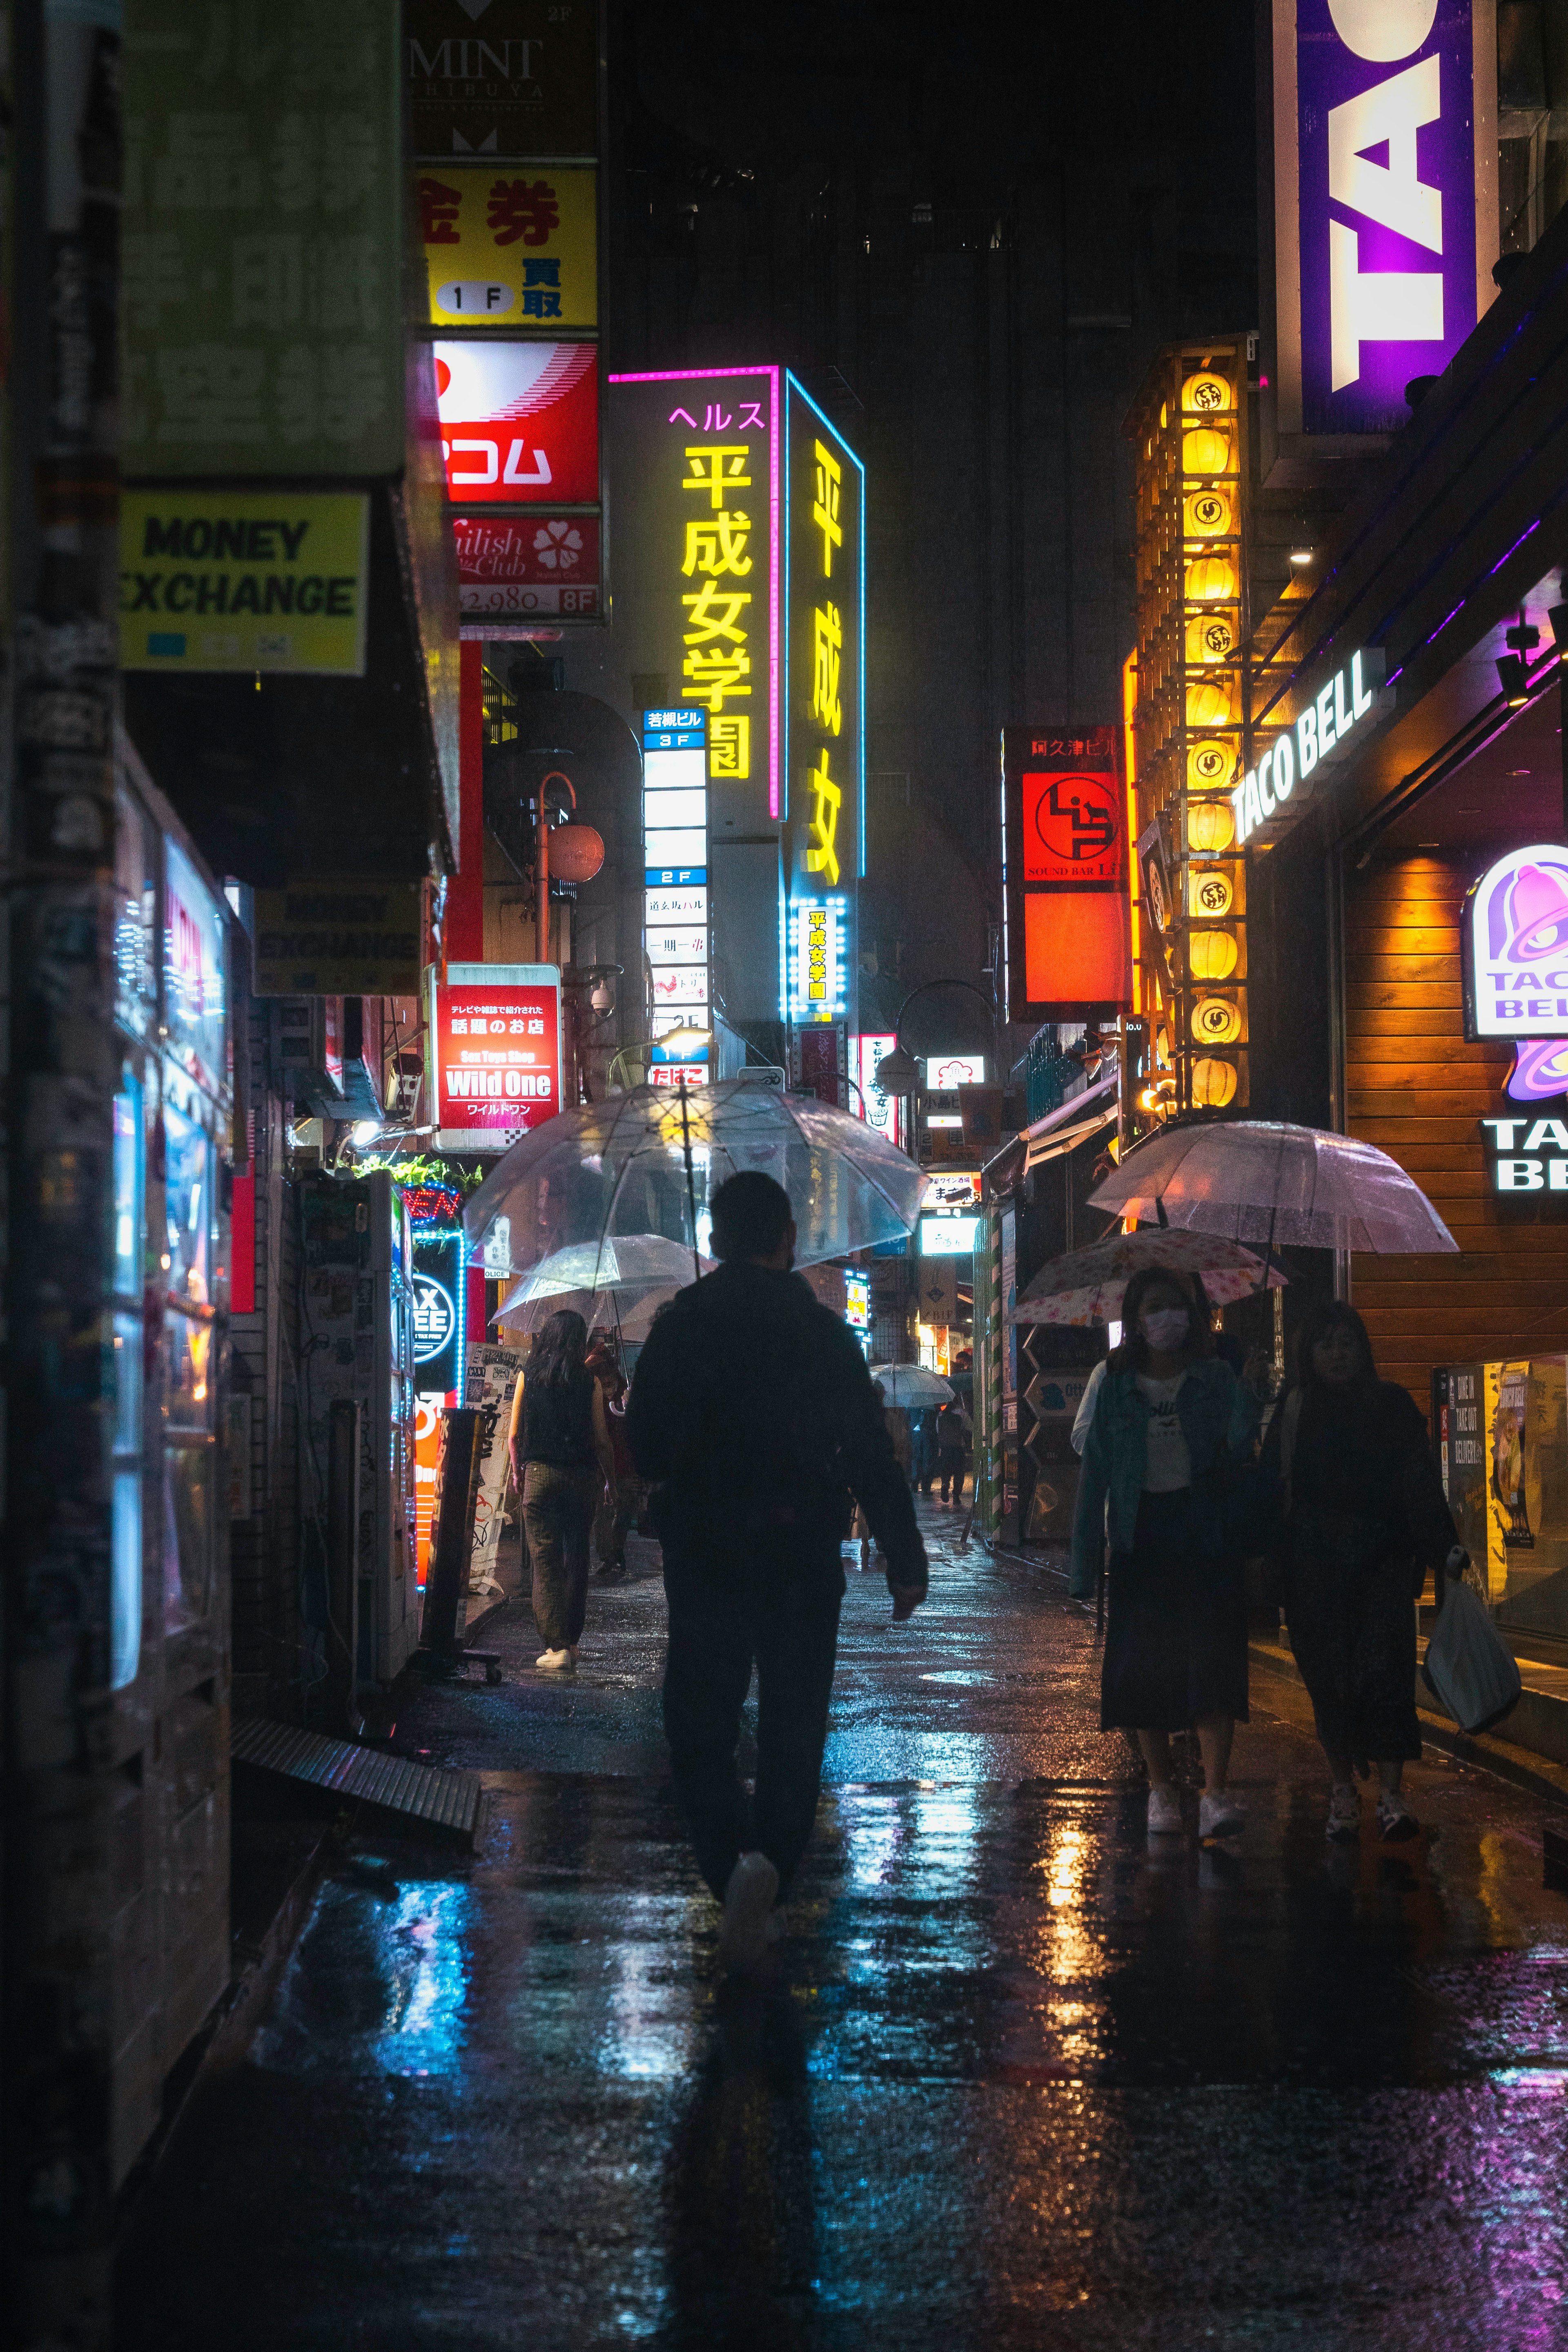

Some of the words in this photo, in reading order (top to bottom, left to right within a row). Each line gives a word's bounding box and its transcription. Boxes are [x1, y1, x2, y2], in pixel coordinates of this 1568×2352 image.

[548, 6, 572, 22] 2F
[409, 38, 543, 79] MINT
[419, 178, 559, 246] 金券
[522, 258, 562, 318] 買取
[668, 403, 765, 431] ヘルス
[444, 439, 552, 485] コム
[142, 517, 310, 561] MONEY
[474, 555, 526, 576] Club
[564, 591, 592, 611] 8F
[681, 445, 753, 779] 平成女学園
[648, 712, 701, 728] 若槻ビル
[1031, 740, 1115, 756] 阿久津ビル
[1231, 734, 1294, 845] TACO
[1297, 649, 1372, 779] BELL
[808, 911, 826, 1000] 平成女学園
[451, 1006, 543, 1014] テレビや雑誌で紹介された
[451, 1019, 544, 1034] 話題のお店
[461, 1051, 479, 1063] Sex
[481, 1051, 506, 1063] Toys
[508, 1051, 535, 1064] Shop
[446, 1071, 501, 1096] Wild
[505, 1071, 551, 1096] One
[653, 1068, 702, 1086] たばこ
[467, 1104, 530, 1115] ワイルドワン
[413, 1310, 447, 1331] EE
[1458, 1376, 1469, 1400] DINE
[1456, 1407, 1468, 1431] TAKE
[1468, 1407, 1477, 1431] OUT
[1456, 1440, 1476, 1464] DELIVERY
